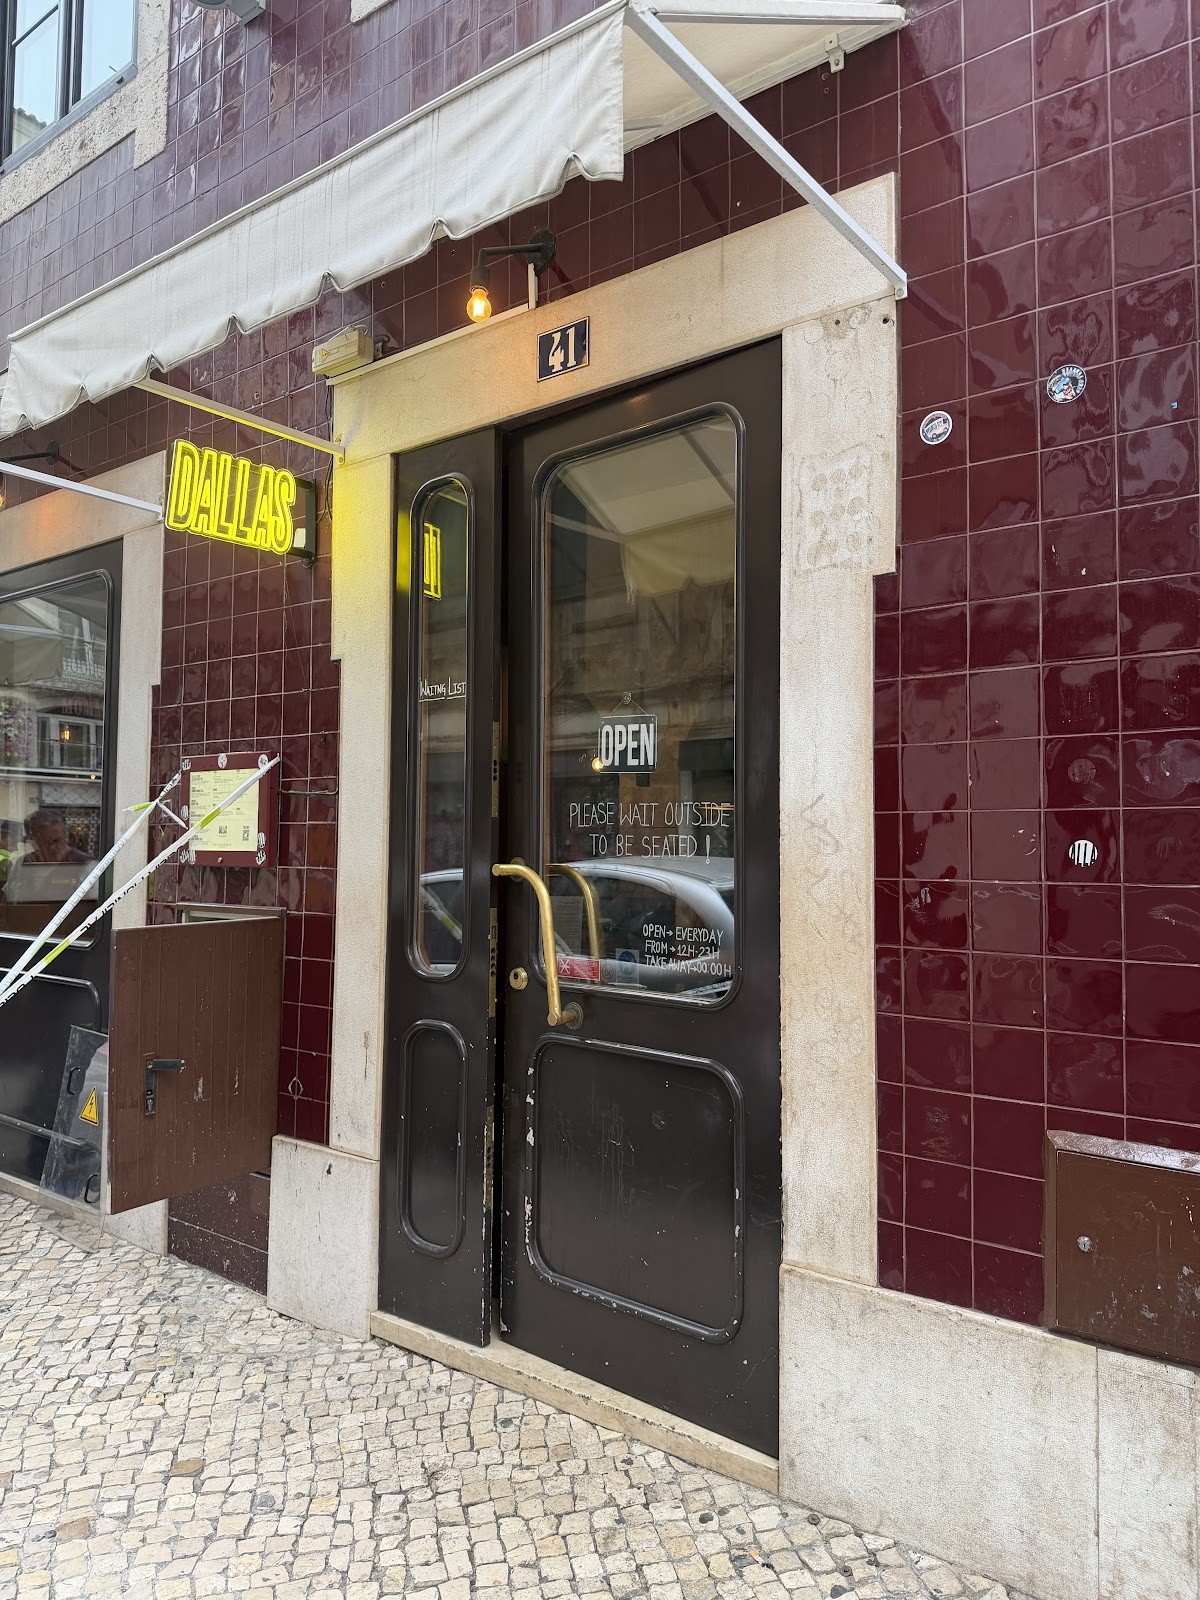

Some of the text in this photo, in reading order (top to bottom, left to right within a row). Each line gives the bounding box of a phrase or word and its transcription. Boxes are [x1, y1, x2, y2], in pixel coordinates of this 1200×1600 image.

[548, 326, 577, 372] 41
[166, 440, 295, 554] DALLAS
[448, 676, 467, 696] LIST
[601, 723, 655, 766] OPEN
[569, 801, 731, 828] PLEASE WAIT OUTSIDE
[588, 833, 608, 856] TO
[615, 834, 634, 857] BE
[641, 834, 698, 859] SEATED
[642, 923, 724, 946] OPEN EVERYDAY
[645, 940, 668, 955] FROM
